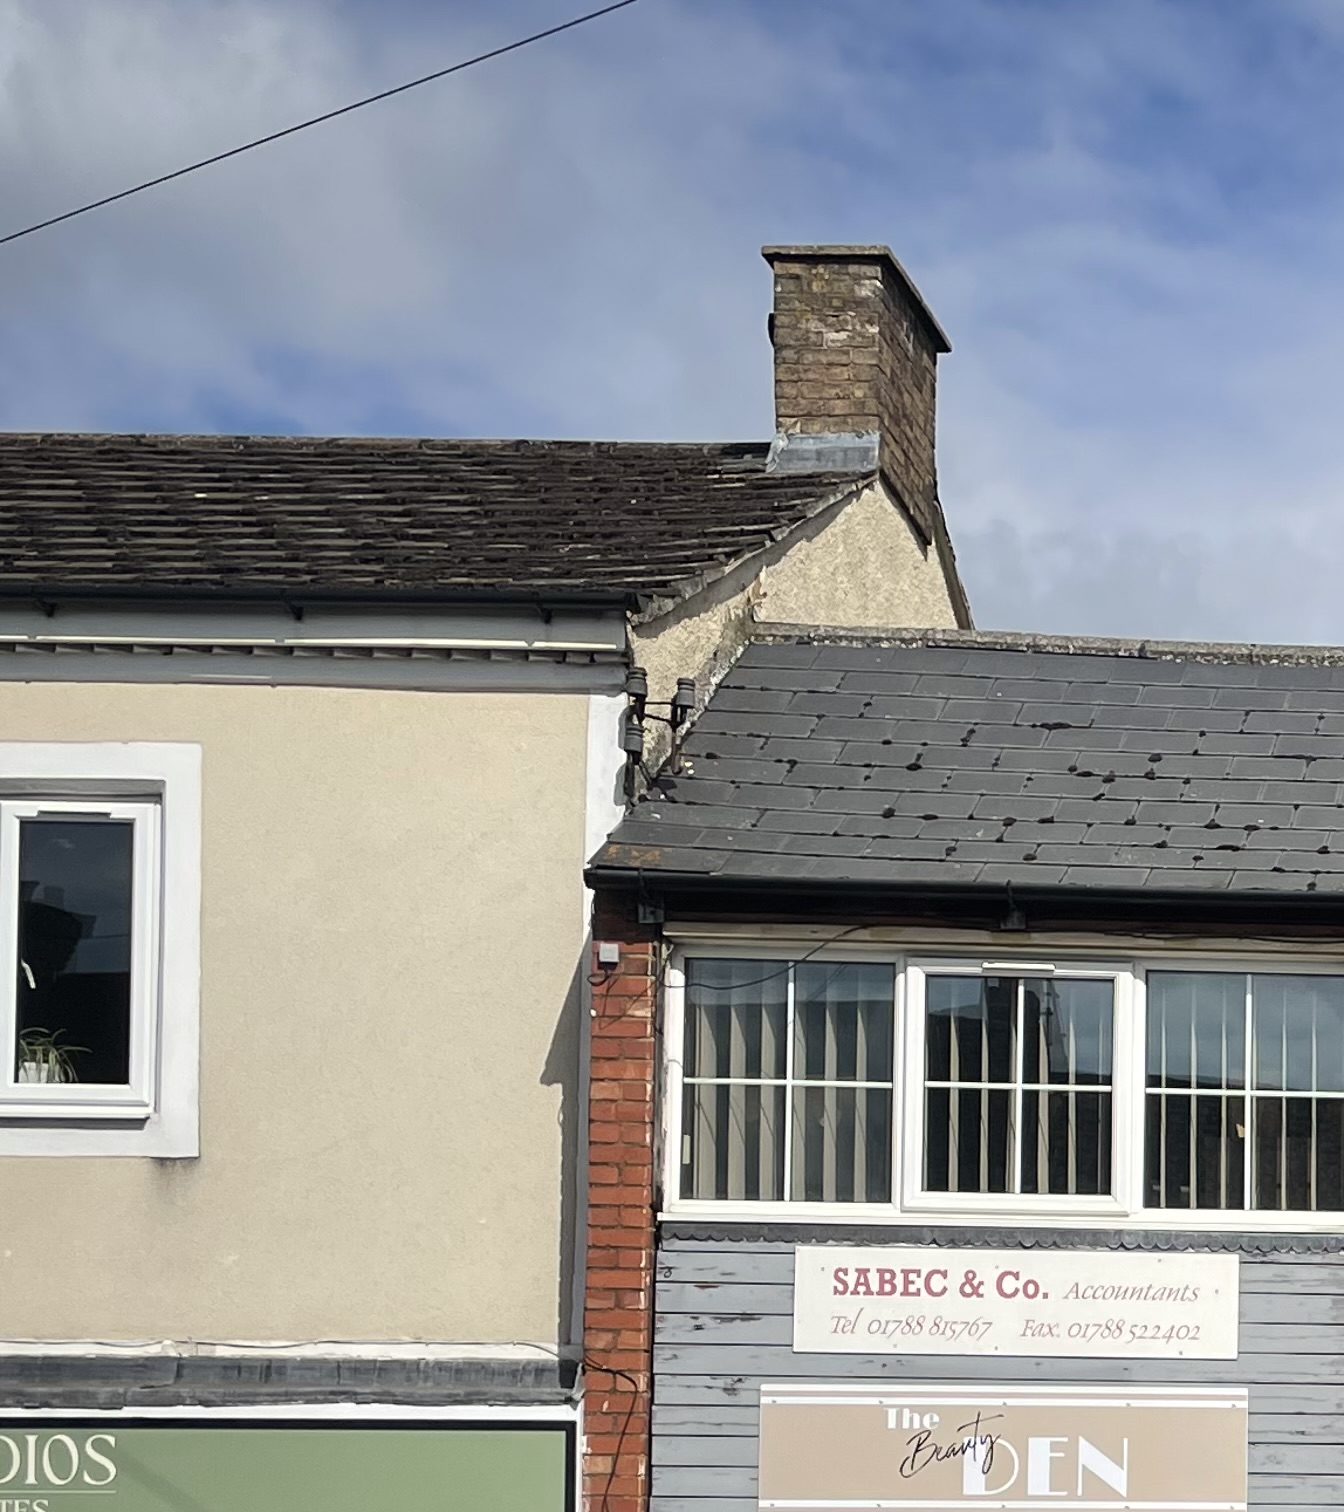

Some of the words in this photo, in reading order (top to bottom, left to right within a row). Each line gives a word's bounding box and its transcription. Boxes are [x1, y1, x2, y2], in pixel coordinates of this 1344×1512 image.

[832, 1267, 948, 1298] SABEC
[958, 1270, 985, 1299] &
[995, 1269, 1050, 1300] Co.
[1062, 1281, 1201, 1304] Accountants
[830, 1306, 861, 1335] Tel
[867, 1314, 927, 1340] 01788
[928, 1314, 994, 1342] 815767
[1067, 1318, 1126, 1343] 01788
[1128, 1322, 1201, 1345] 522402
[883, 1407, 941, 1431] The
[899, 1411, 1005, 1479] Beauty
[961, 1436, 1129, 1498] DEN
